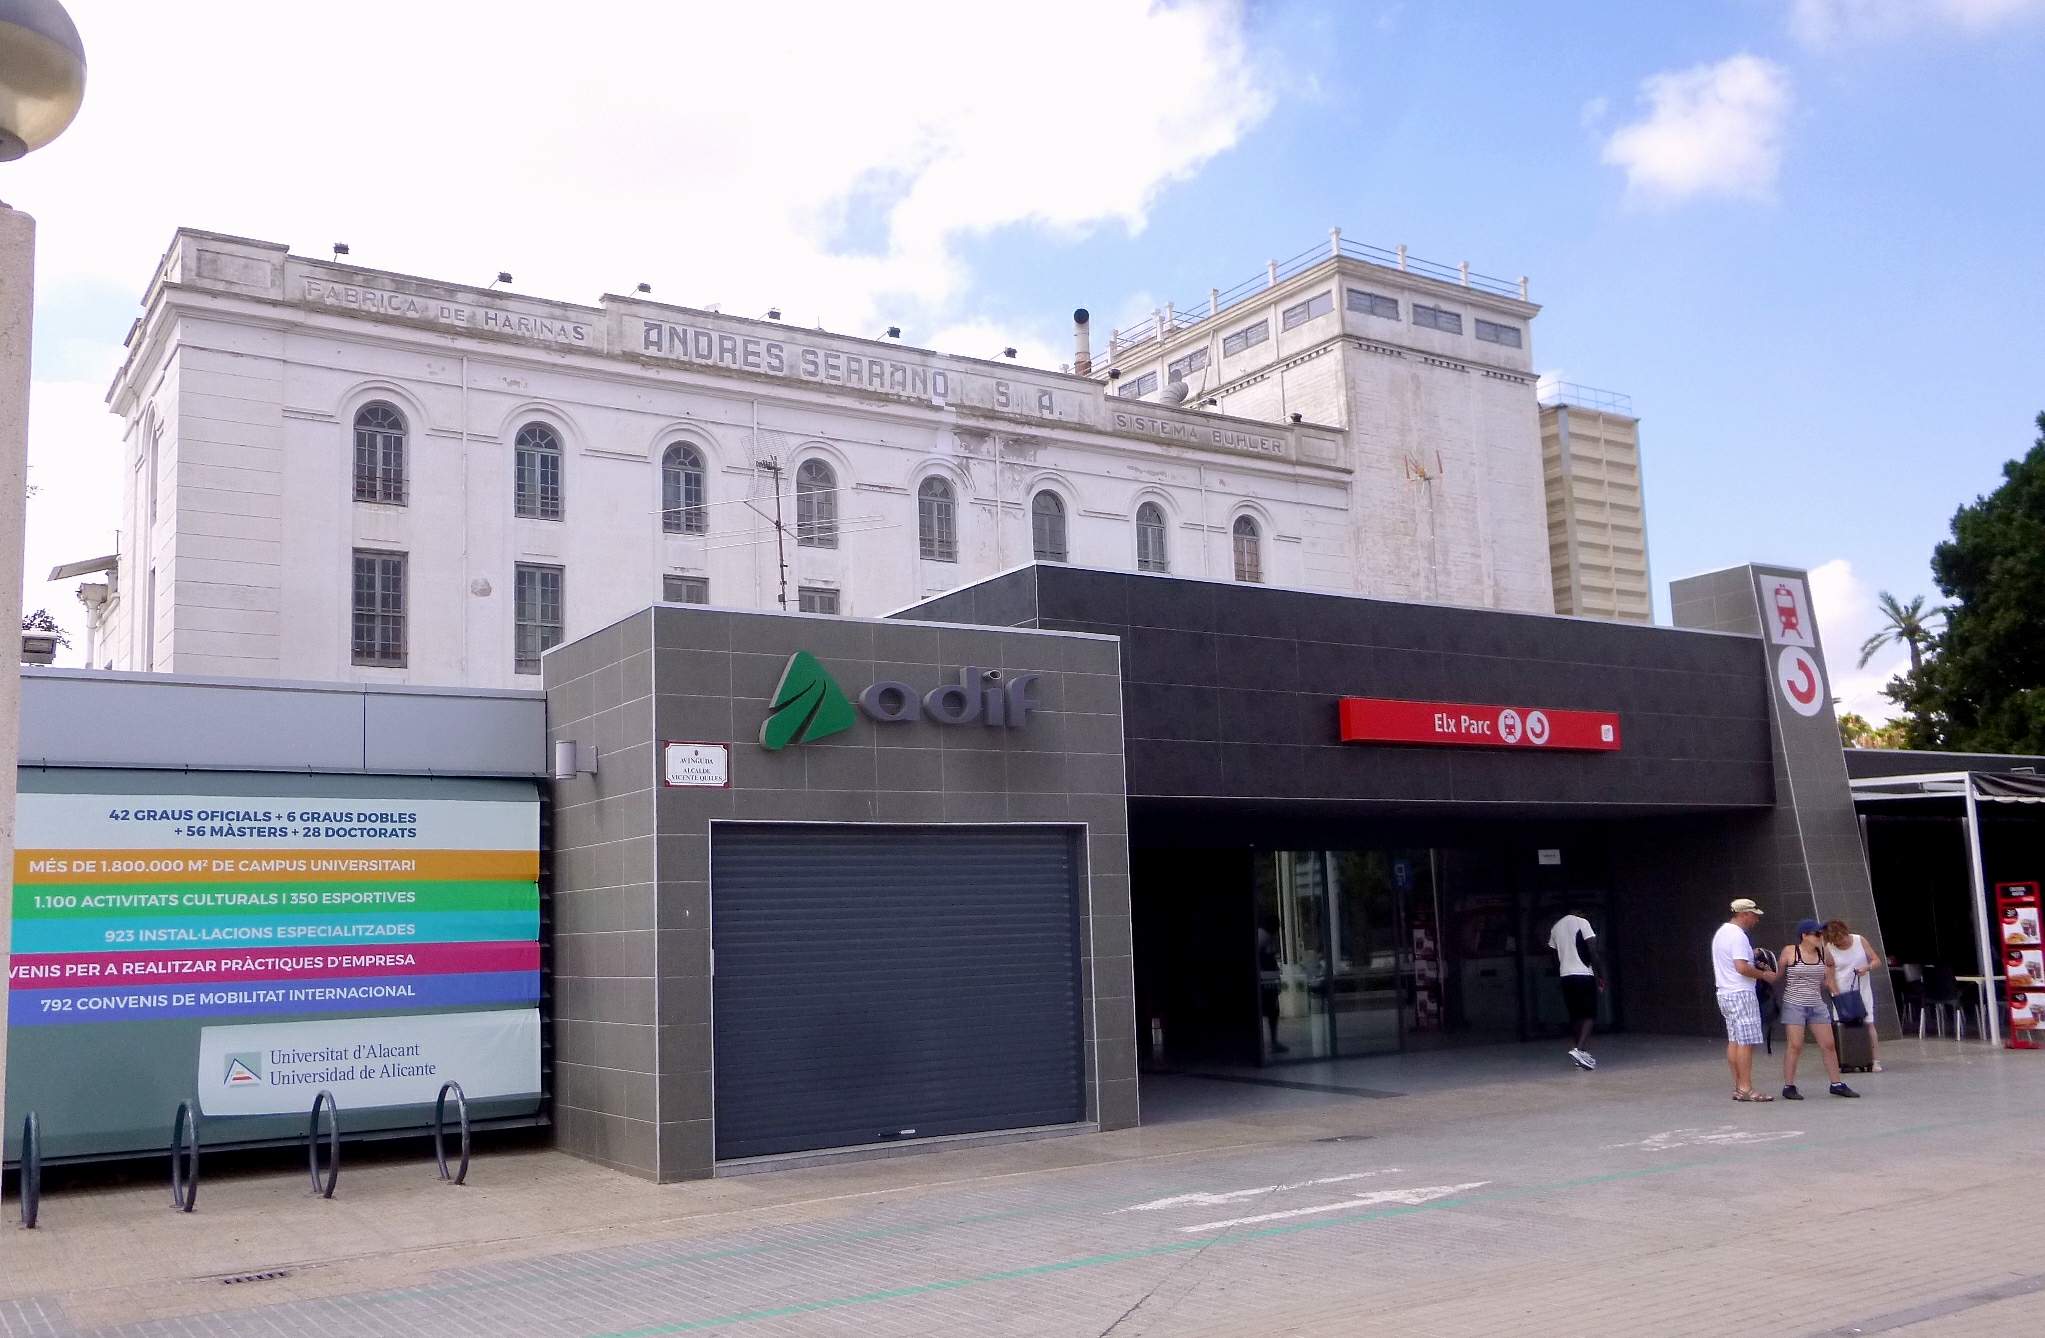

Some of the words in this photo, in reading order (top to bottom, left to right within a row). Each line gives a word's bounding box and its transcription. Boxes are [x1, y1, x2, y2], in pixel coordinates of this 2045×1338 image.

[305, 280, 420, 315] FABRICA
[439, 305, 466, 322] DE
[483, 310, 586, 342] HARINAS
[643, 320, 784, 373] ANDRES
[801, 348, 949, 399] SERRANO
[1116, 414, 1199, 439] SISTEMA
[1211, 429, 1283, 454] BUHLER
[858, 665, 1042, 728] adif
[1434, 713, 1456, 733] Elx
[1461, 715, 1492, 735] Parc
[109, 809, 130, 821] 42
[134, 809, 194, 822] GRAUS
[196, 809, 272, 823] OFICIALS
[275, 813, 283, 821] +
[286, 811, 297, 823] 6
[299, 811, 354, 824] GRAUS
[356, 812, 417, 824] DOBLES
[174, 827, 183, 836] +
[186, 825, 206, 837] 56
[209, 823, 288, 838] MÀSTERS
[291, 828, 299, 836] +
[302, 826, 321, 838] 28
[324, 827, 417, 839] DOCTORATS
[29, 858, 68, 873] MÉS
[72, 860, 97, 873] DE
[100, 859, 184, 873] 1.800.000
[212, 859, 235, 873] DE
[238, 859, 307, 872] CAMPUS
[310, 859, 416, 871] UNIVERSITARI
[34, 895, 77, 909] 1.100
[80, 893, 179, 908] ACTIVITATS
[182, 893, 279, 906] CULTURALS
[289, 892, 319, 905] 350
[322, 891, 416, 904] ESPORTIVES
[104, 929, 135, 943] 923
[139, 926, 273, 941] INSTAL·LACIONS
[276, 923, 416, 939] ESPECIALITZADES
[9, 964, 61, 979] VENIS
[65, 962, 101, 977] PER
[104, 962, 118, 976] A
[122, 959, 217, 975] REALITZAR
[220, 955, 324, 972] PRÀCTIQUES
[327, 953, 416, 969] D'EMPRESA
[40, 998, 73, 1012] 792
[76, 994, 169, 1010] CONVENIS
[172, 993, 196, 1007] DE
[199, 989, 286, 1005] MOBILITAT
[289, 984, 416, 1001] INTERNACIONAL
[270, 1048, 350, 1065] Universitat
[269, 1066, 356, 1086] Universidad
[359, 1064, 377, 1080] de
[379, 1062, 437, 1079] Alicante
